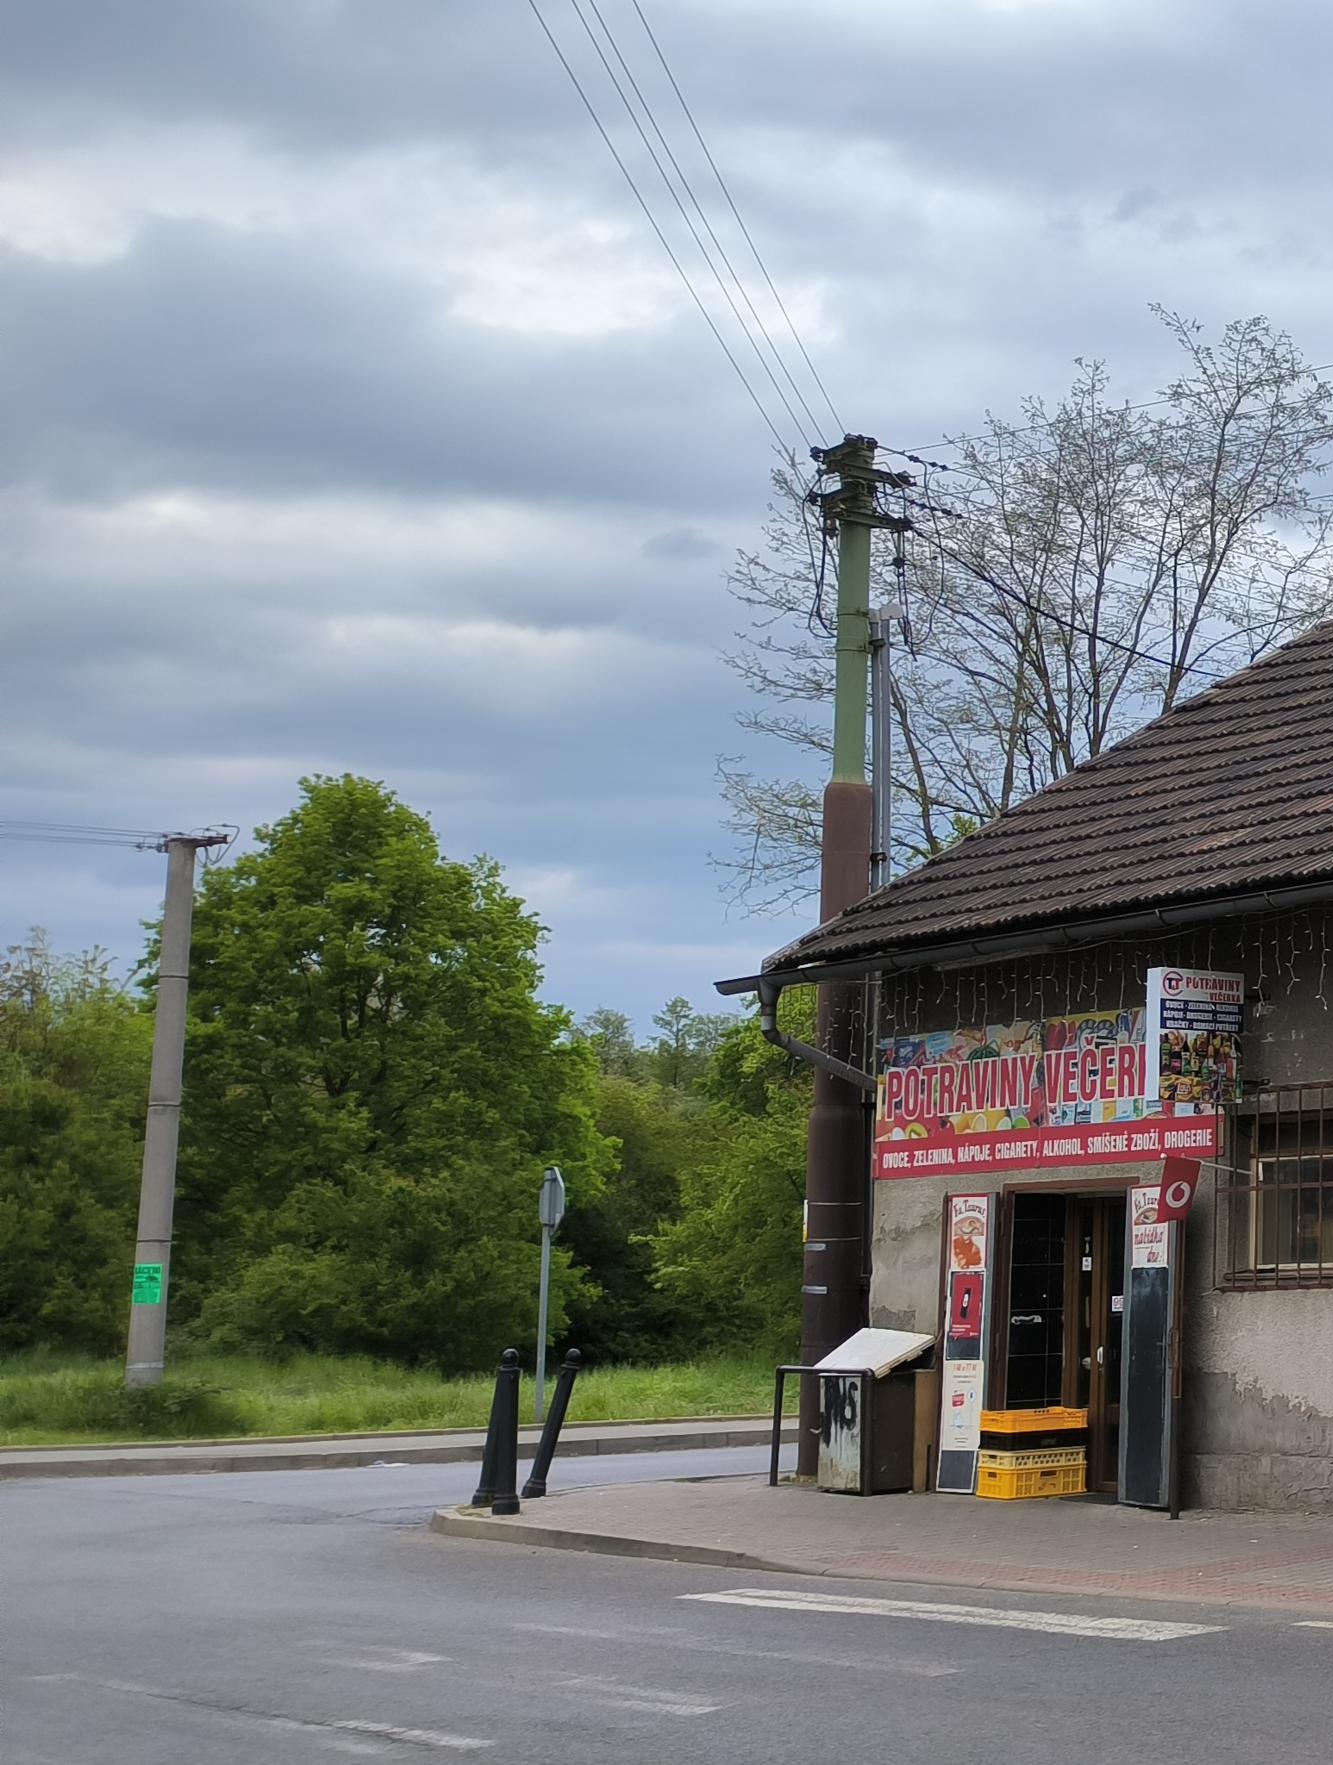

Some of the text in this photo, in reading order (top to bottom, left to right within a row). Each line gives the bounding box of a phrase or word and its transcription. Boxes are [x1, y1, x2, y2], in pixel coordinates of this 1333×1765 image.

[1186, 977, 1240, 992] POTRAVINY
[884, 1053, 1037, 1122] POTRAVINY
[883, 1128, 1213, 1169] OVOCE, ZELENINA, NÁPOJE, CIGARETY, ALKOHOL, SMÍŠENÉ ZBOŽÍ, DROGERIE
